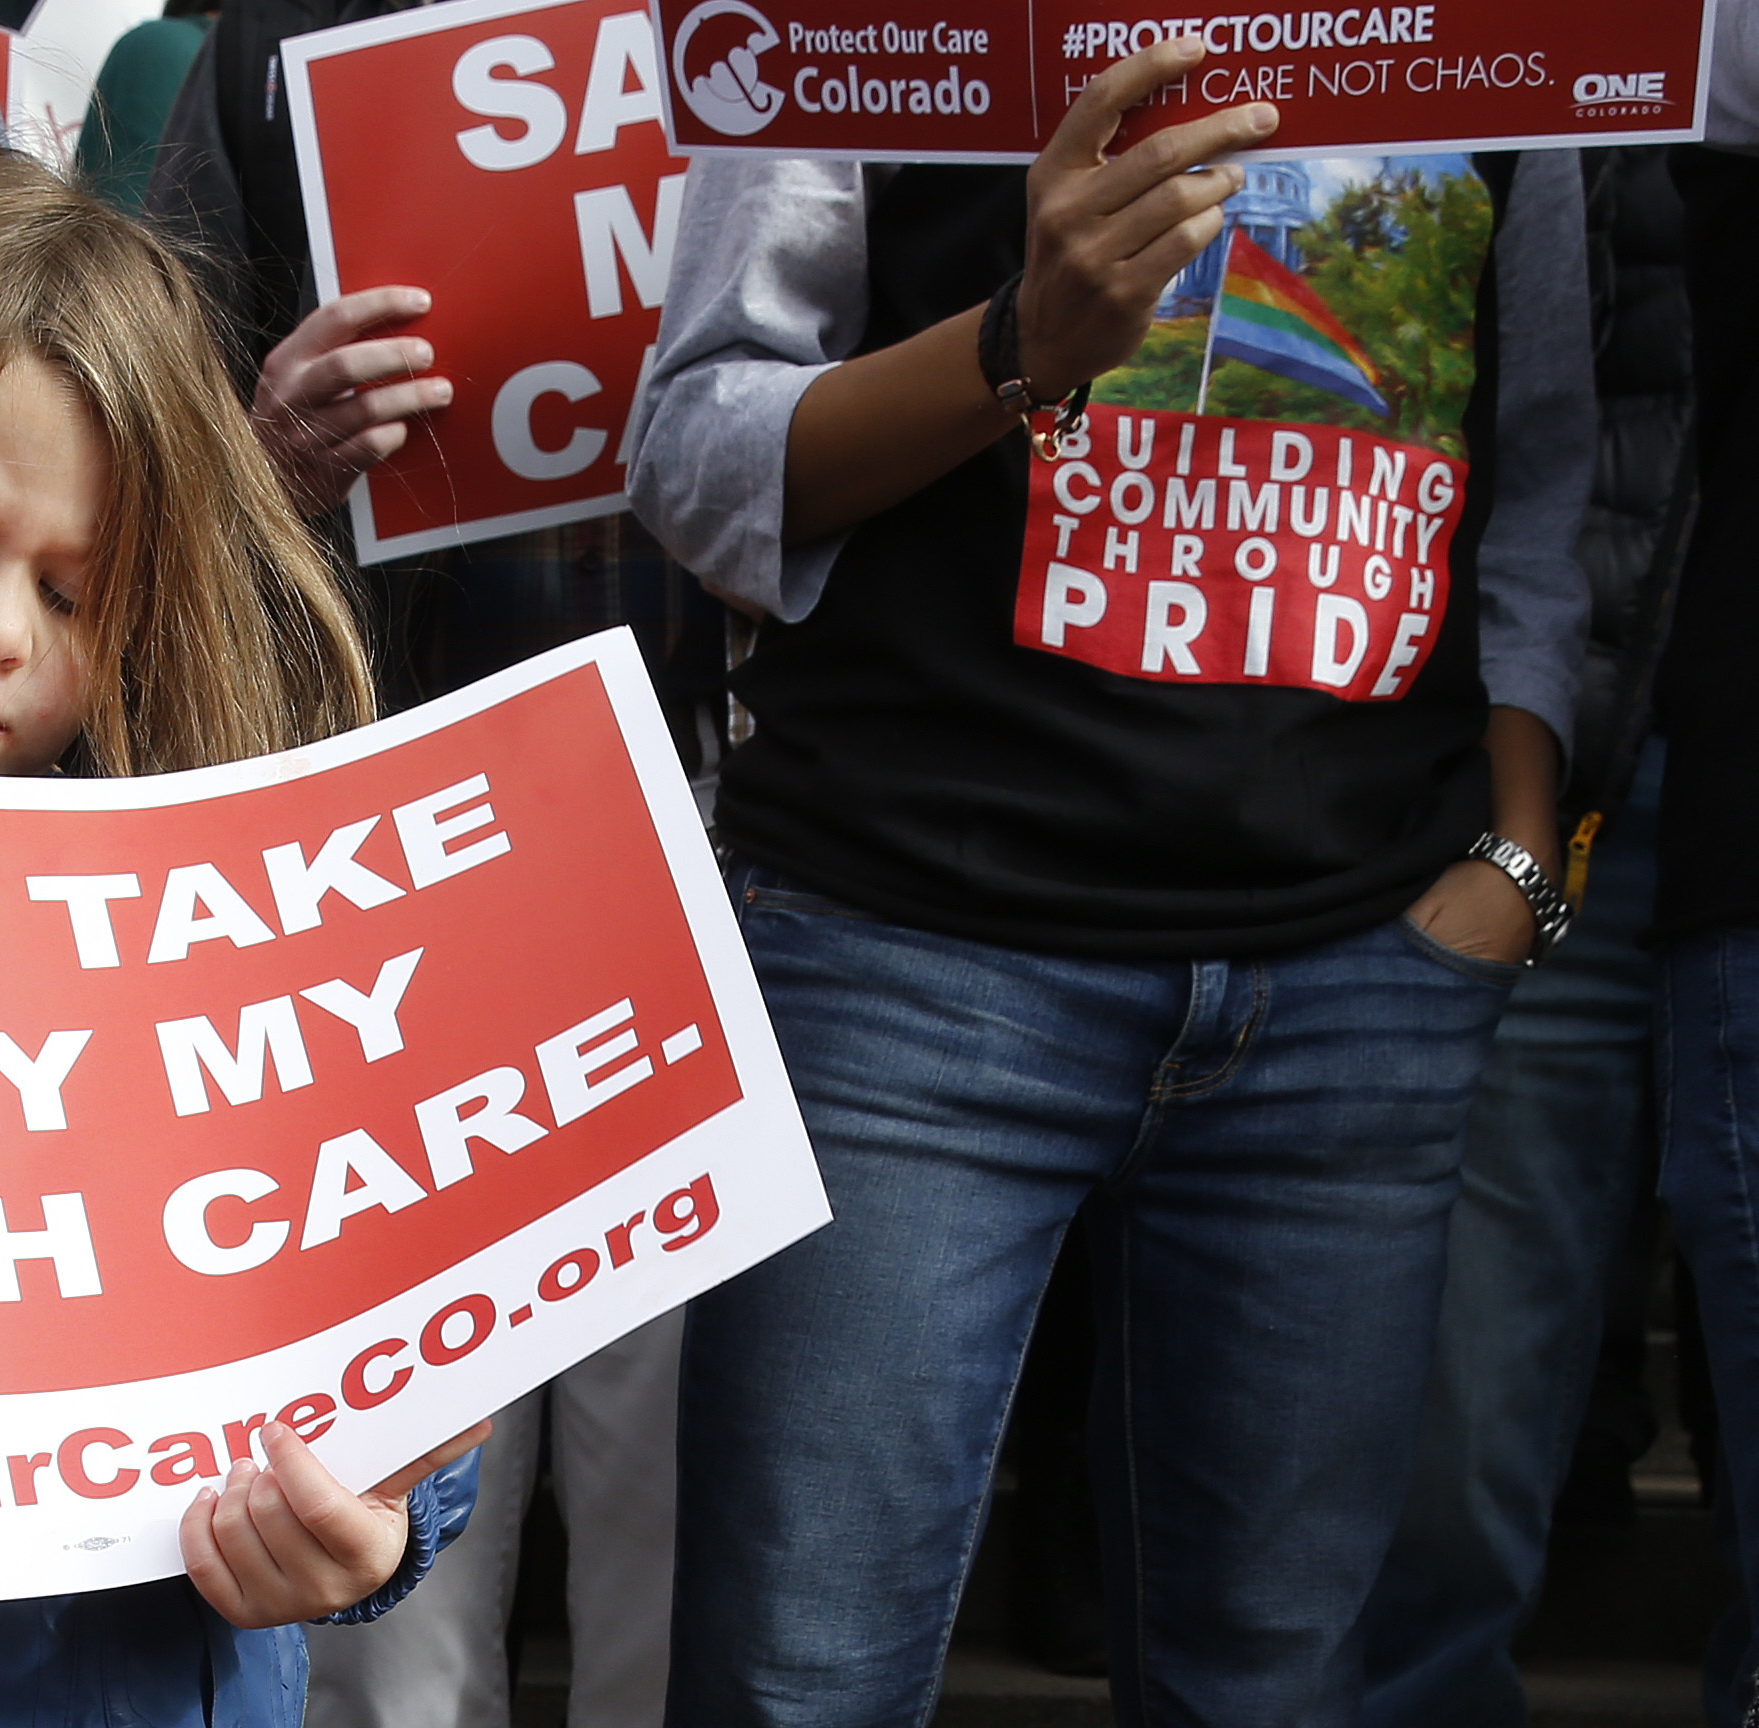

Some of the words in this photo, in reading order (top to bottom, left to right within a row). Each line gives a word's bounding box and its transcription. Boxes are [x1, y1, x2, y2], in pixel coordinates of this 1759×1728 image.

[788, 21, 878, 53] Protect
[882, 20, 928, 53] Our
[932, 20, 989, 54] Care
[1201, 64, 1294, 104] CARE
[1308, 58, 1395, 97] NOT
[1405, 51, 1555, 94] CHAOS.
[1572, 71, 1666, 103] ONE
[793, 64, 991, 115] Colorado
[1575, 104, 1663, 118] COLORADO
[1055, 406, 1454, 515] BUILDING
[1052, 459, 1444, 565] COMMUNITY
[1052, 514, 1436, 610] THROUGH
[1040, 561, 1431, 698] PRIDE
[25, 771, 513, 970] TAKE
[154, 946, 425, 1119] MY
[161, 997, 704, 1277] CARE.
